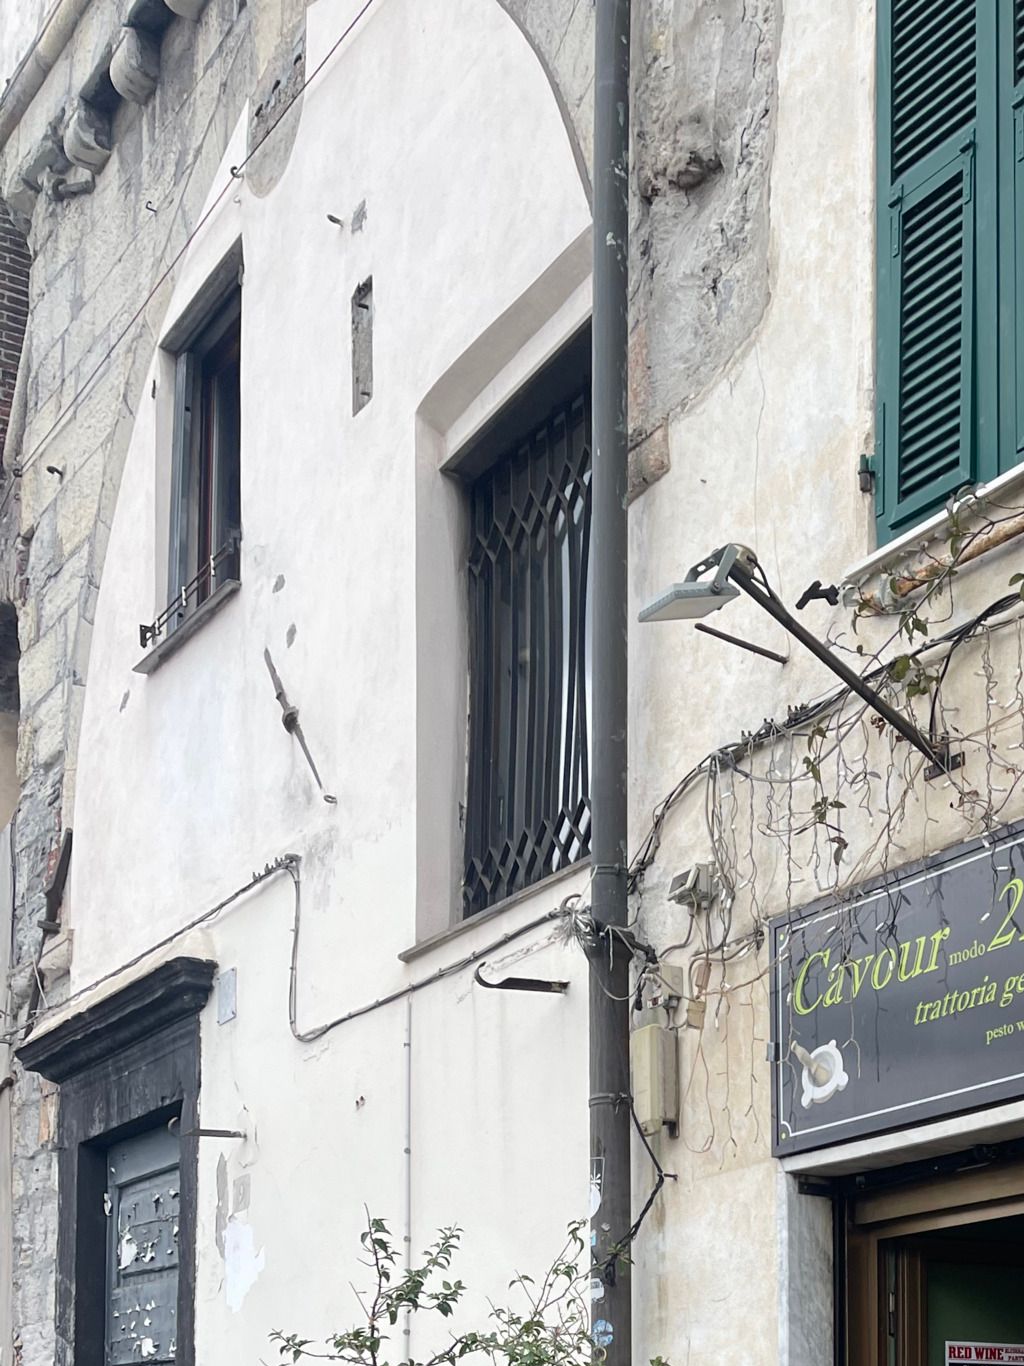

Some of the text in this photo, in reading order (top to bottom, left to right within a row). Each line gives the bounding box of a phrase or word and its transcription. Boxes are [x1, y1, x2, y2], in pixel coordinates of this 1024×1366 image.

[793, 927, 950, 1016] Cavour
[949, 941, 985, 967] modo
[913, 976, 998, 1026] trattoria
[985, 1023, 1014, 1045] pesto
[948, 1346, 1004, 1360] RED WINE
